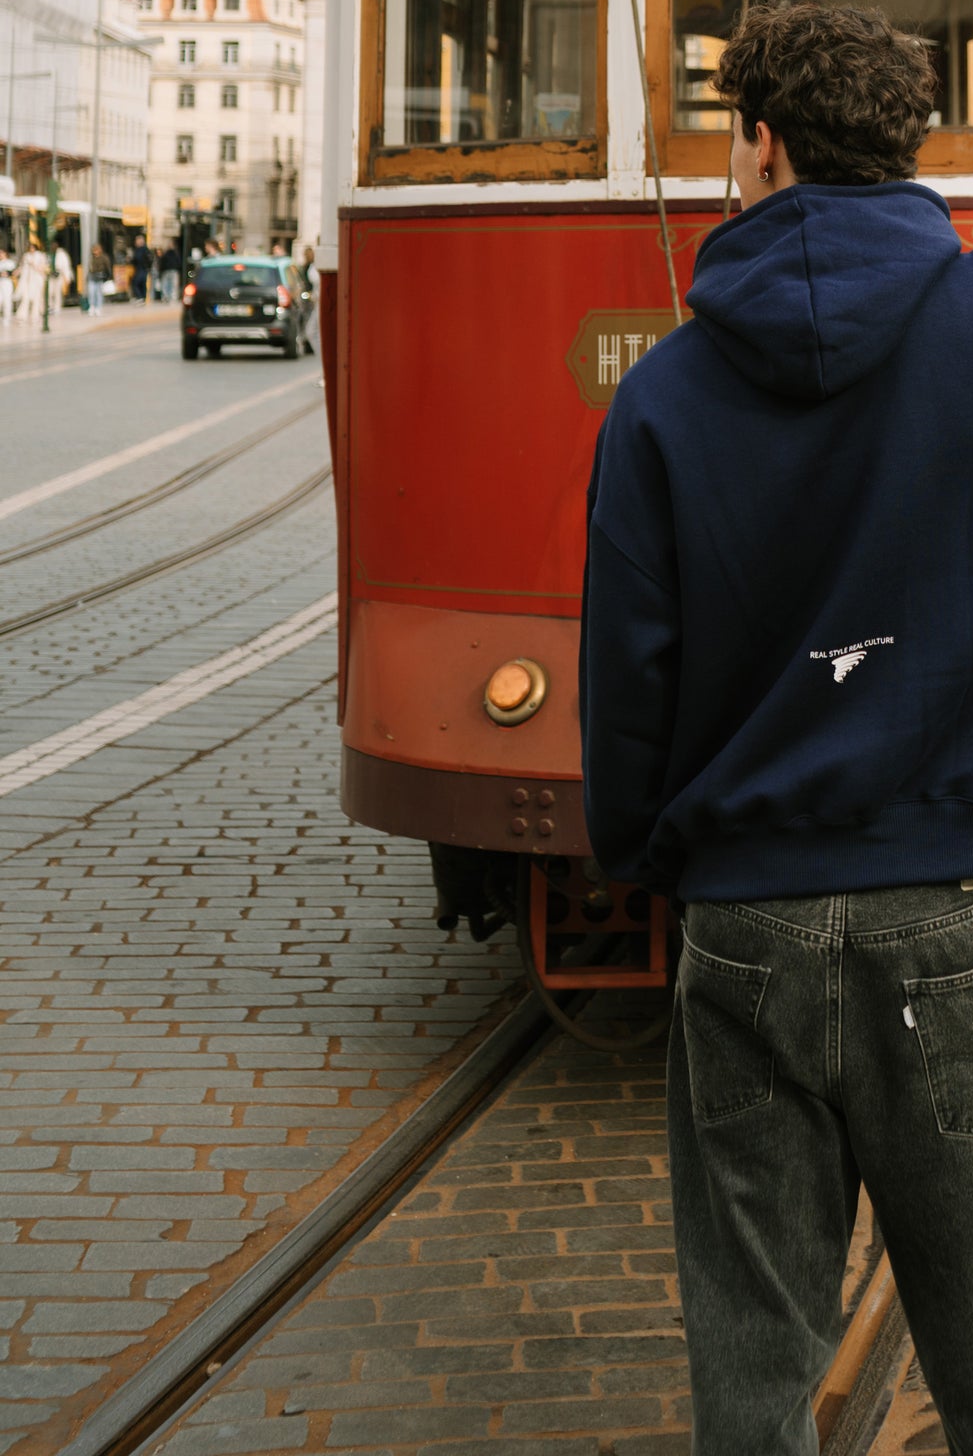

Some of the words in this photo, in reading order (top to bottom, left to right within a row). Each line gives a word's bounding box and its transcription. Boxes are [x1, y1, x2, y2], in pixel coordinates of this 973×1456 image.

[809, 651, 828, 659] REAL
[829, 646, 848, 658] STYLE
[848, 642, 864, 652] REAL
[864, 636, 894, 647] CULTURE
